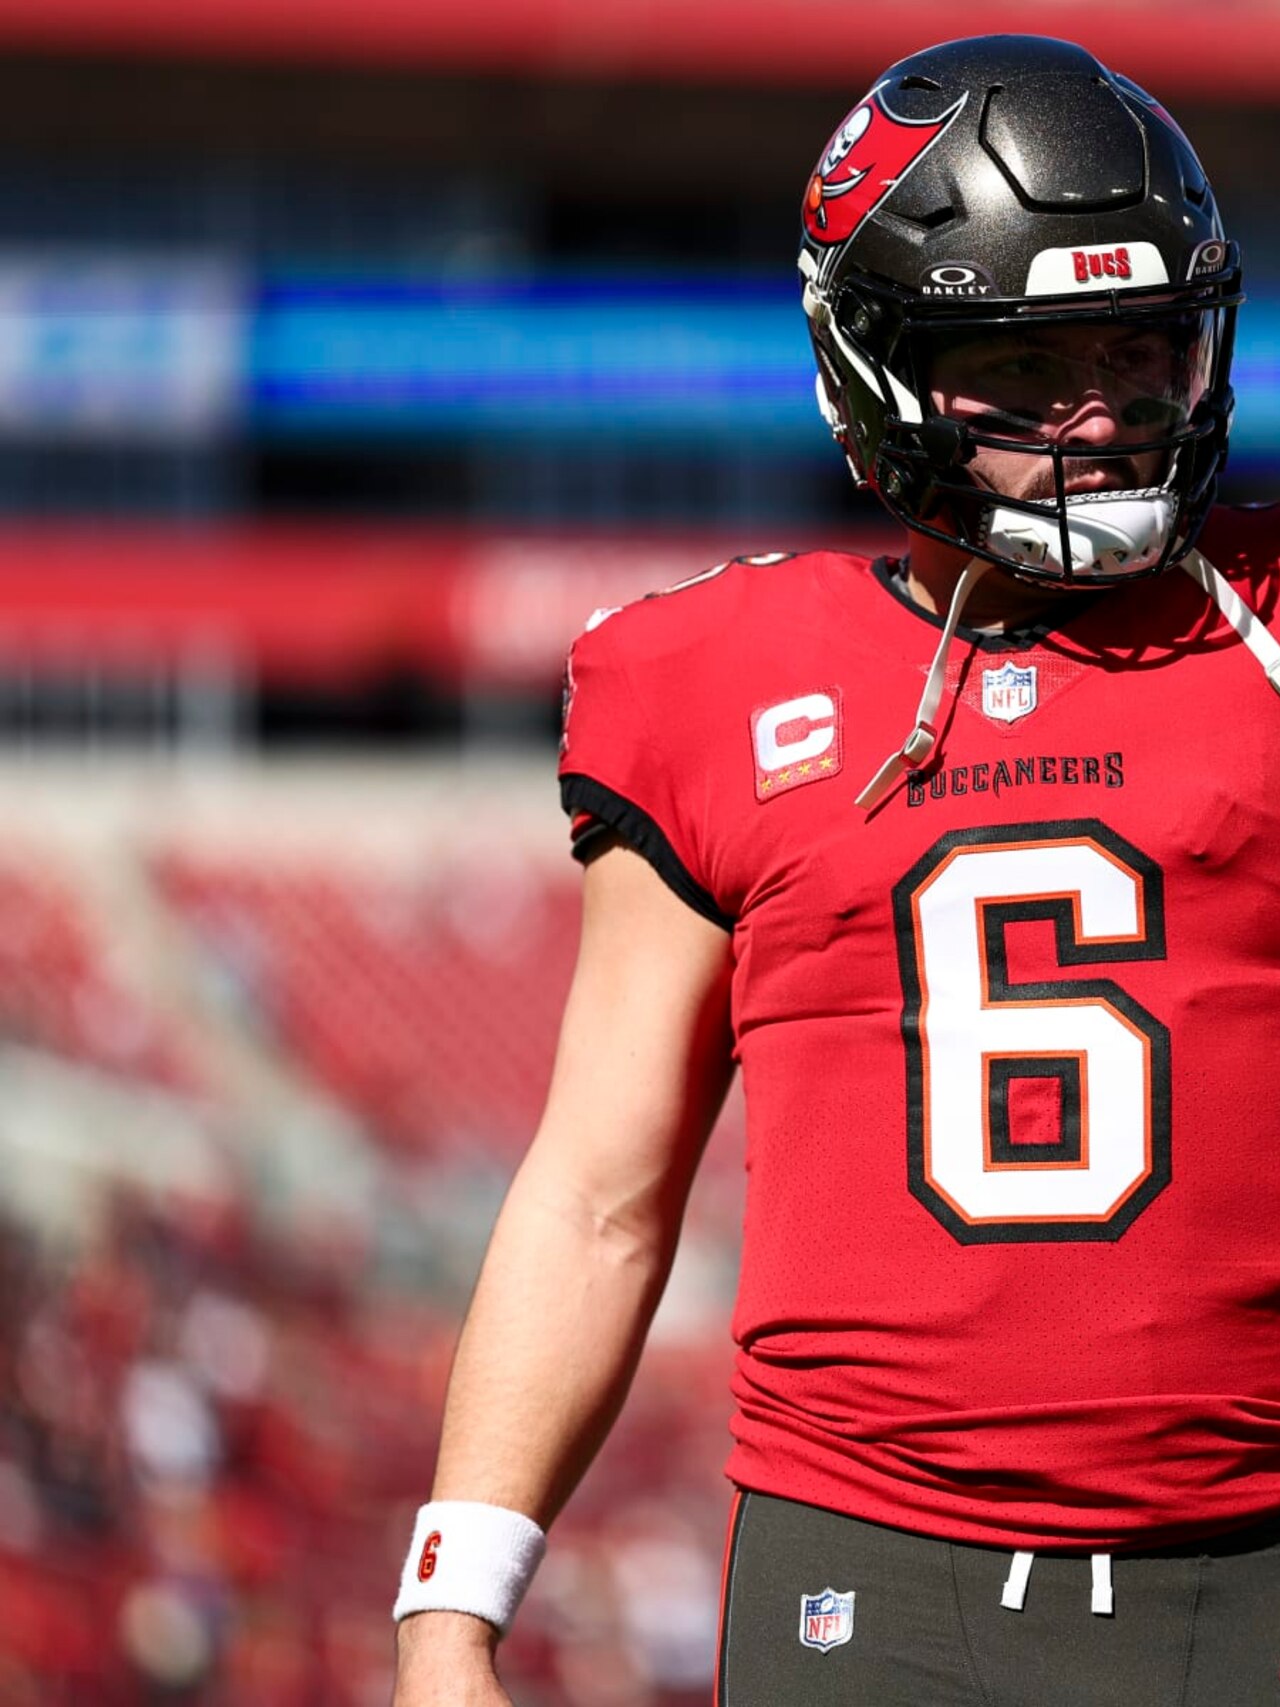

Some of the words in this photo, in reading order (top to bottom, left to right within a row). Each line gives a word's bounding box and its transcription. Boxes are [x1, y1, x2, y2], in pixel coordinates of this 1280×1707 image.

[922, 285, 989, 296] OAKLEY
[1071, 247, 1132, 283] BUCS
[992, 688, 1028, 708] NFL
[756, 693, 835, 771] C
[907, 752, 1124, 808] BUCCANEERS
[892, 818, 1172, 1246] 6
[417, 1530, 441, 1583] 6
